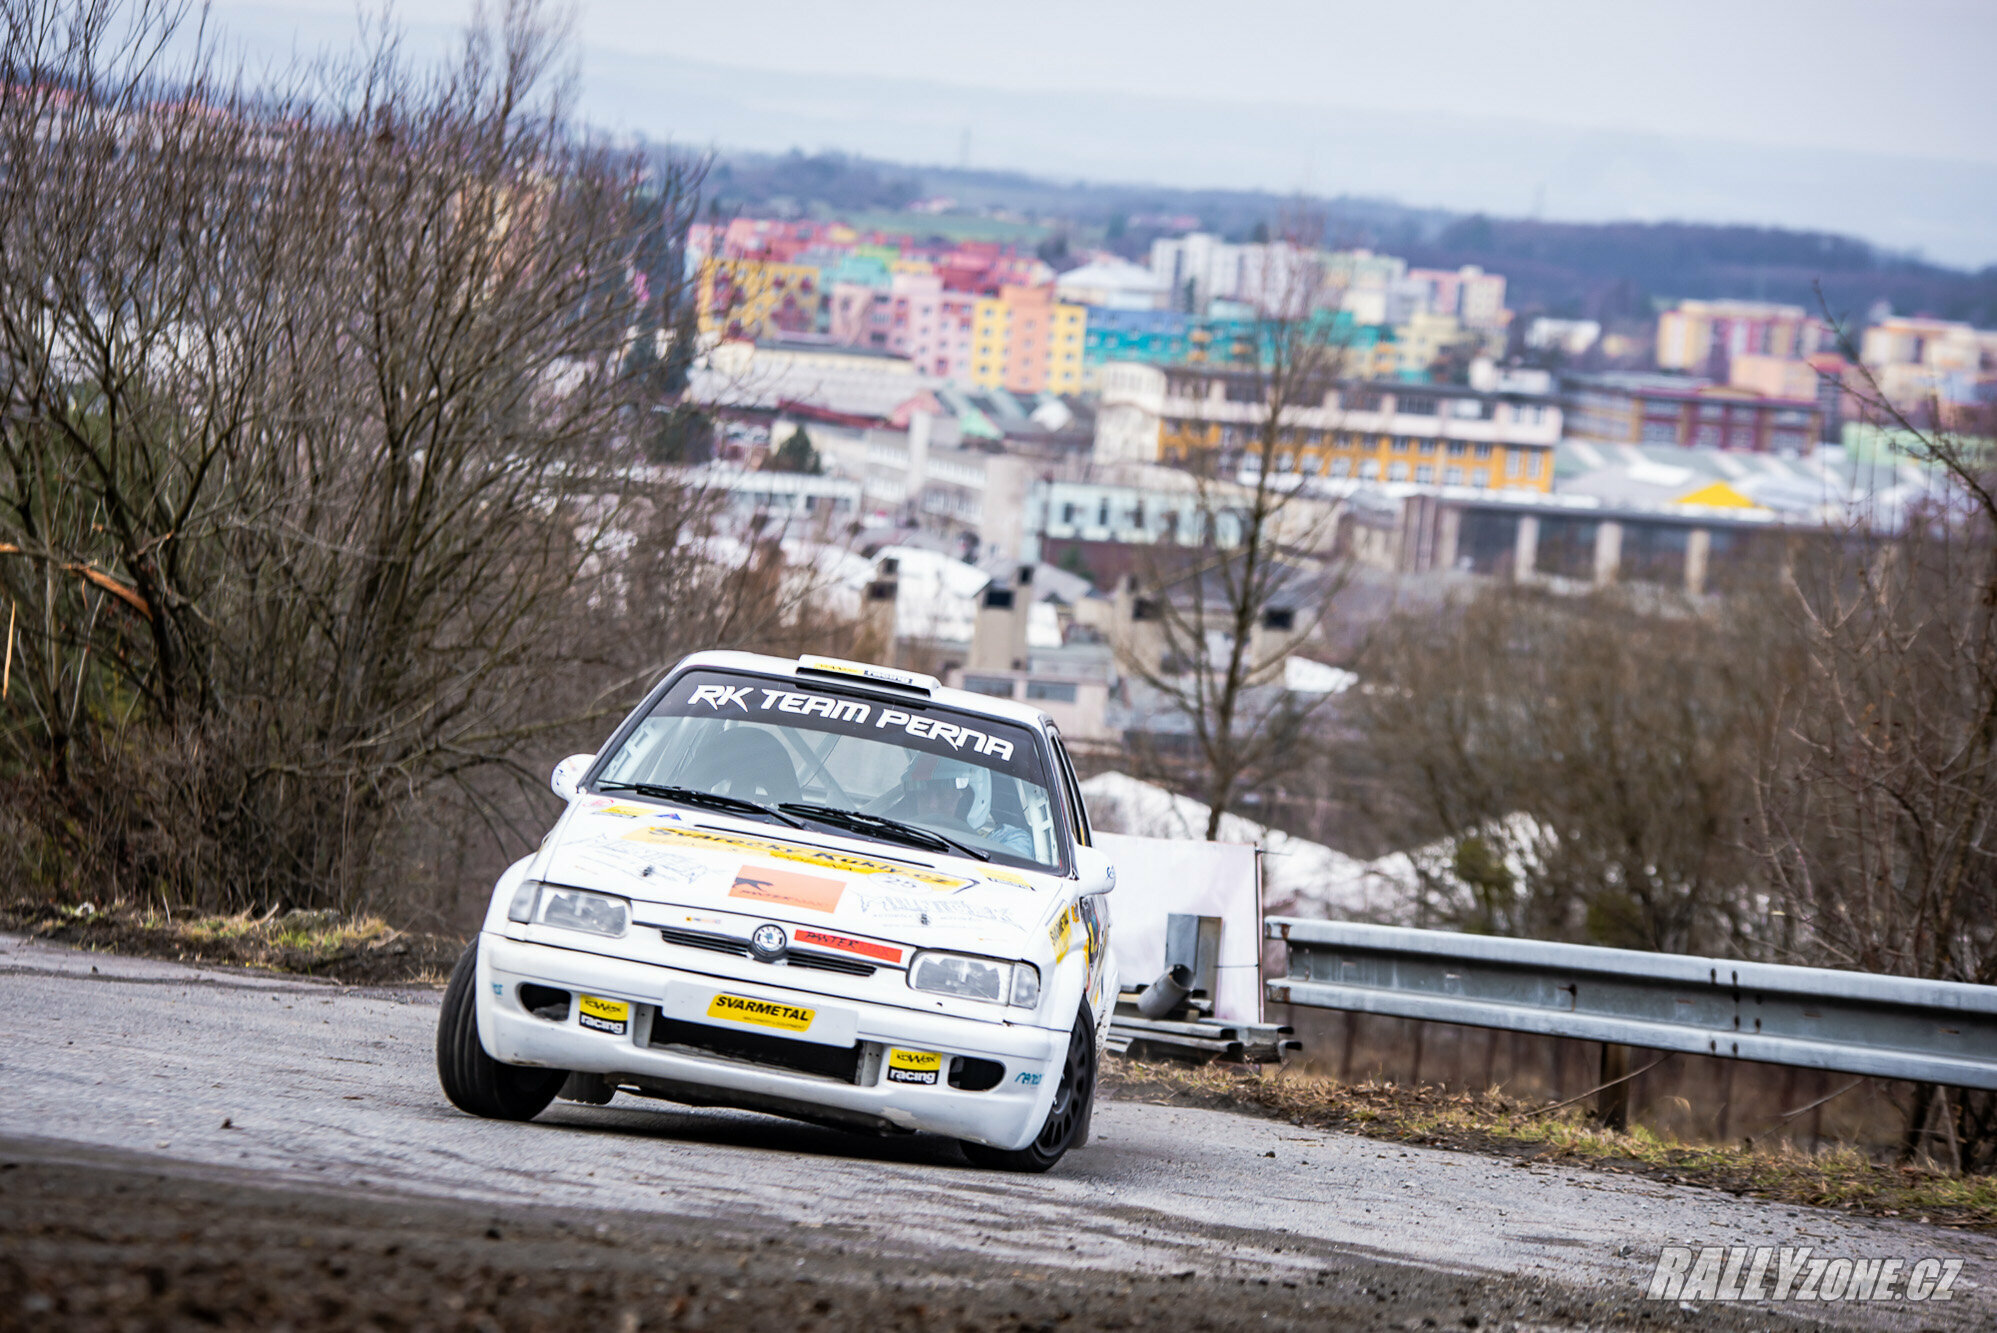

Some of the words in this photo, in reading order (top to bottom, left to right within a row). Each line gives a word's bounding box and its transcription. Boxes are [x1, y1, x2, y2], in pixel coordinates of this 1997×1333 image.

[687, 684, 754, 713] RK
[760, 688, 872, 724] TEAM
[875, 708, 1015, 762] PERNA
[716, 996, 809, 1021] SVARMETAL
[580, 1014, 625, 1034] racing
[889, 1067, 936, 1084] racing
